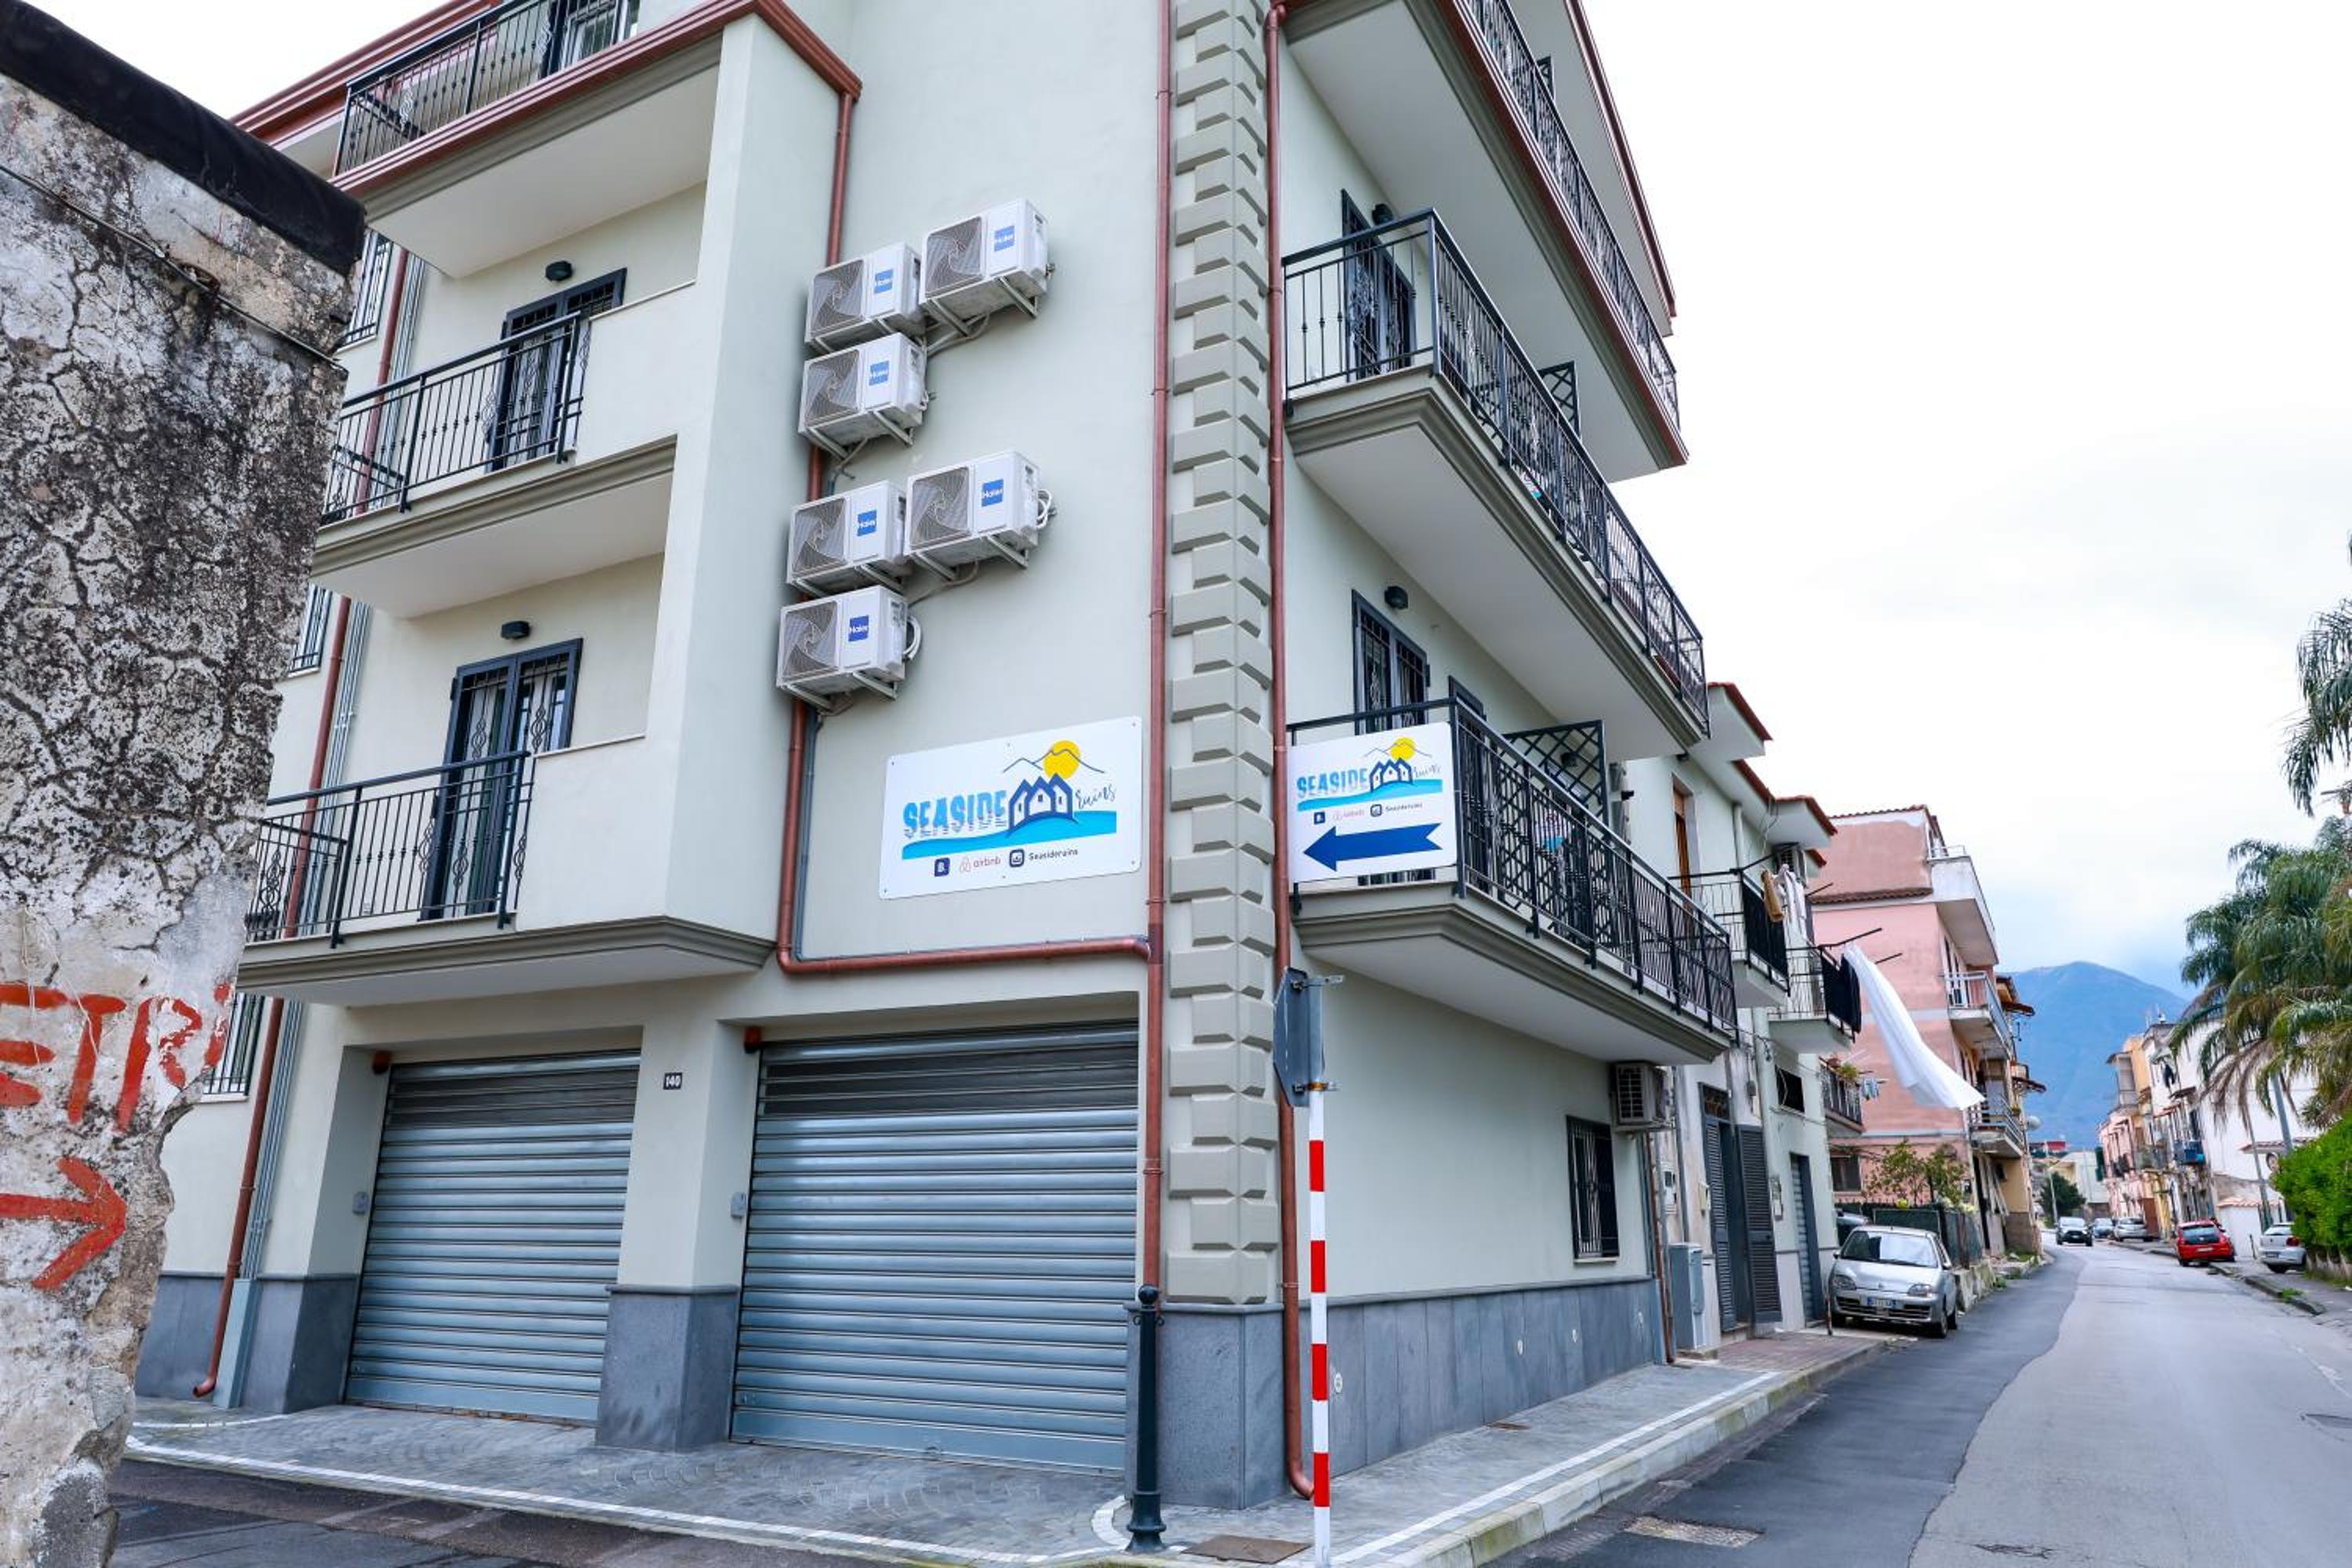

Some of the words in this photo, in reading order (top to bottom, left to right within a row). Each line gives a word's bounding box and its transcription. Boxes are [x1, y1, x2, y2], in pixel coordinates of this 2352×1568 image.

[1297, 768, 1367, 795] SEASIDE
[903, 789, 1007, 836] SEASIDE
[974, 855, 1001, 868] airbnb
